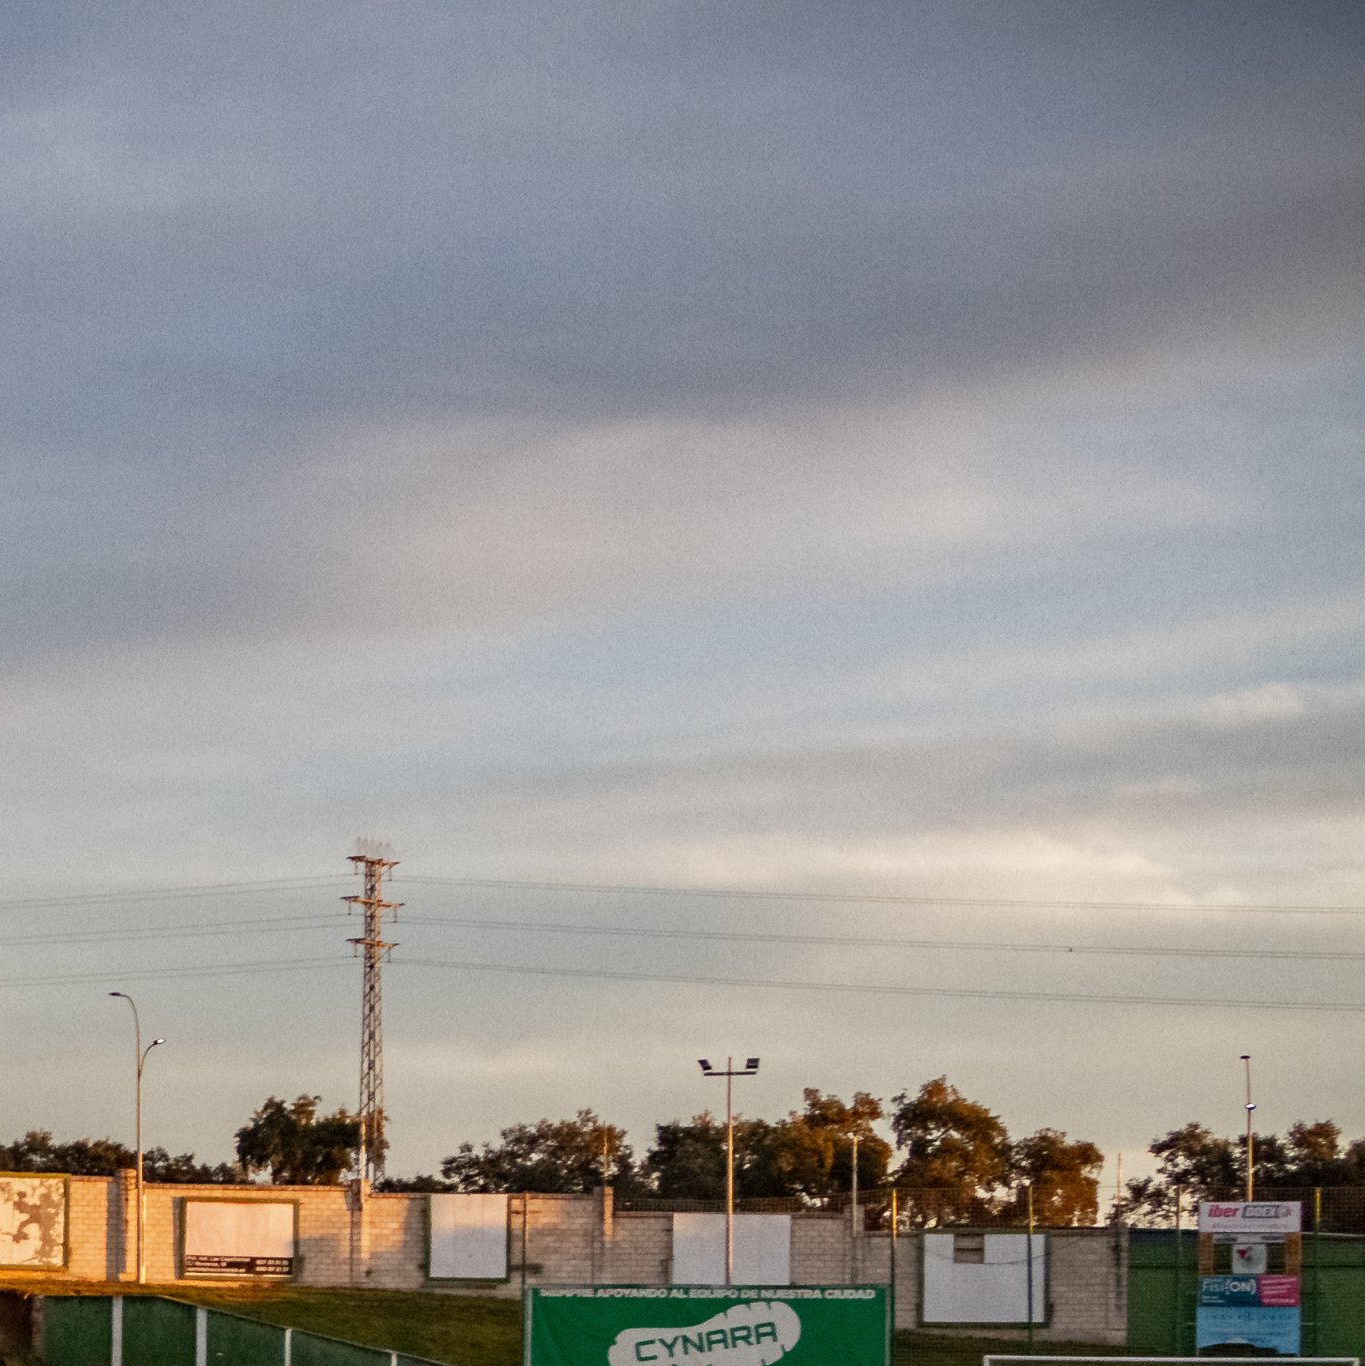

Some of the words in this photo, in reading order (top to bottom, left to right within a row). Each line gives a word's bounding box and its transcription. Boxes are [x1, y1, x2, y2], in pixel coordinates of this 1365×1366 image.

[1208, 1205, 1239, 1218] iber
[596, 1288, 667, 1299] APOYANDO
[671, 1288, 688, 1299] AL
[689, 1288, 738, 1300] EQUIPO
[741, 1289, 758, 1299] DE
[760, 1289, 822, 1300] NUESTRA
[825, 1289, 876, 1300] CIUDAD
[635, 1321, 779, 1363] CYNARA
